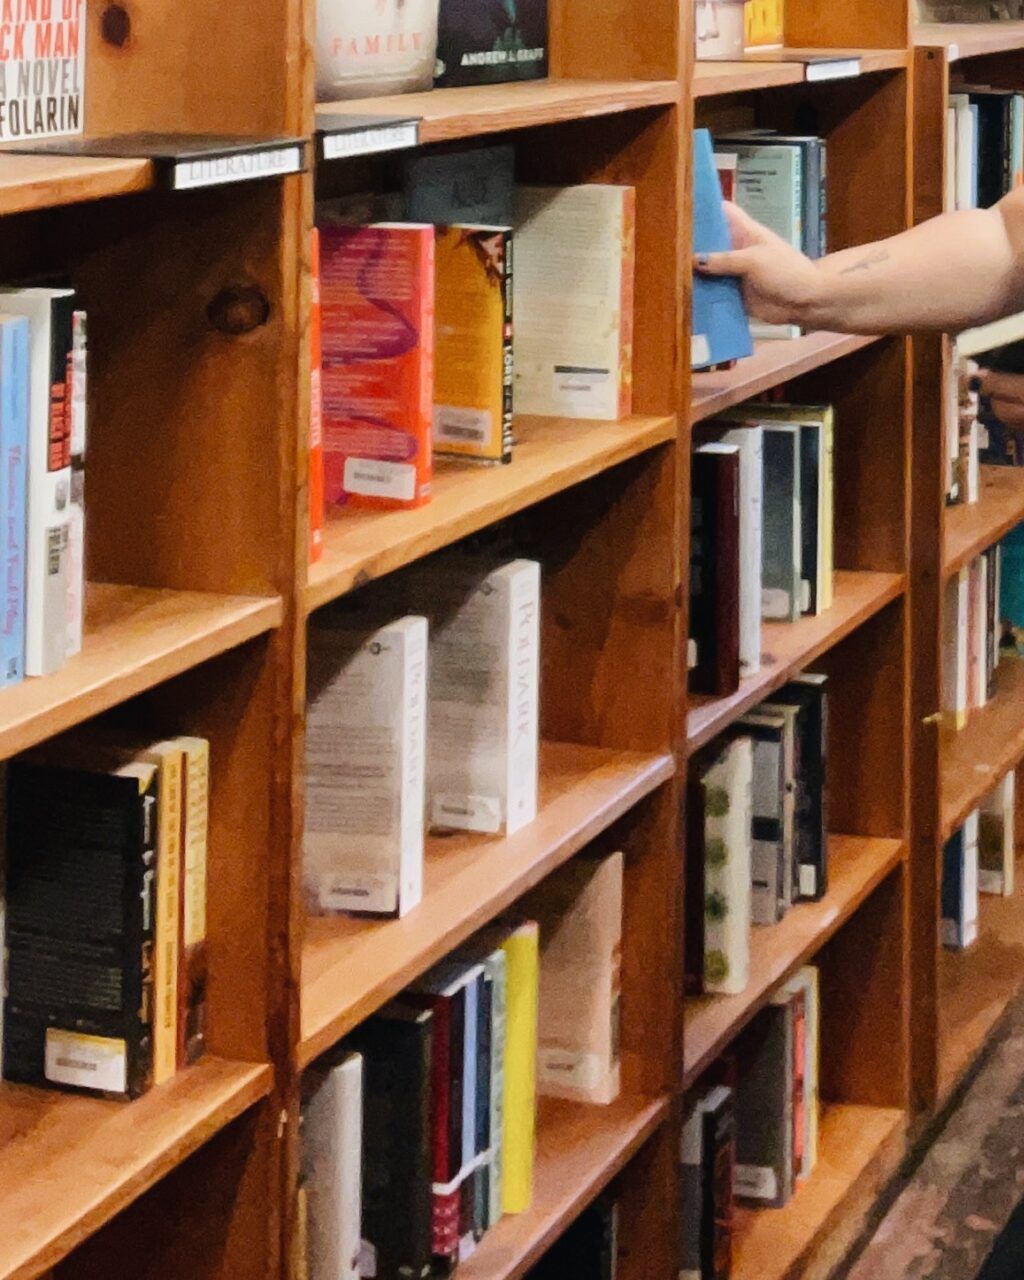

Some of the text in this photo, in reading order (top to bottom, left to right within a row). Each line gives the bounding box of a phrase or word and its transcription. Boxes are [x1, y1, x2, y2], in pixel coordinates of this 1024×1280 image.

[34, 21, 80, 59] MAN
[331, 33, 422, 57] FAMILY
[460, 51, 506, 66] ANDREW
[17, 58, 80, 98] NOVEL
[334, 129, 406, 152] LITERATURE
[188, 152, 287, 180] LITERATURE
